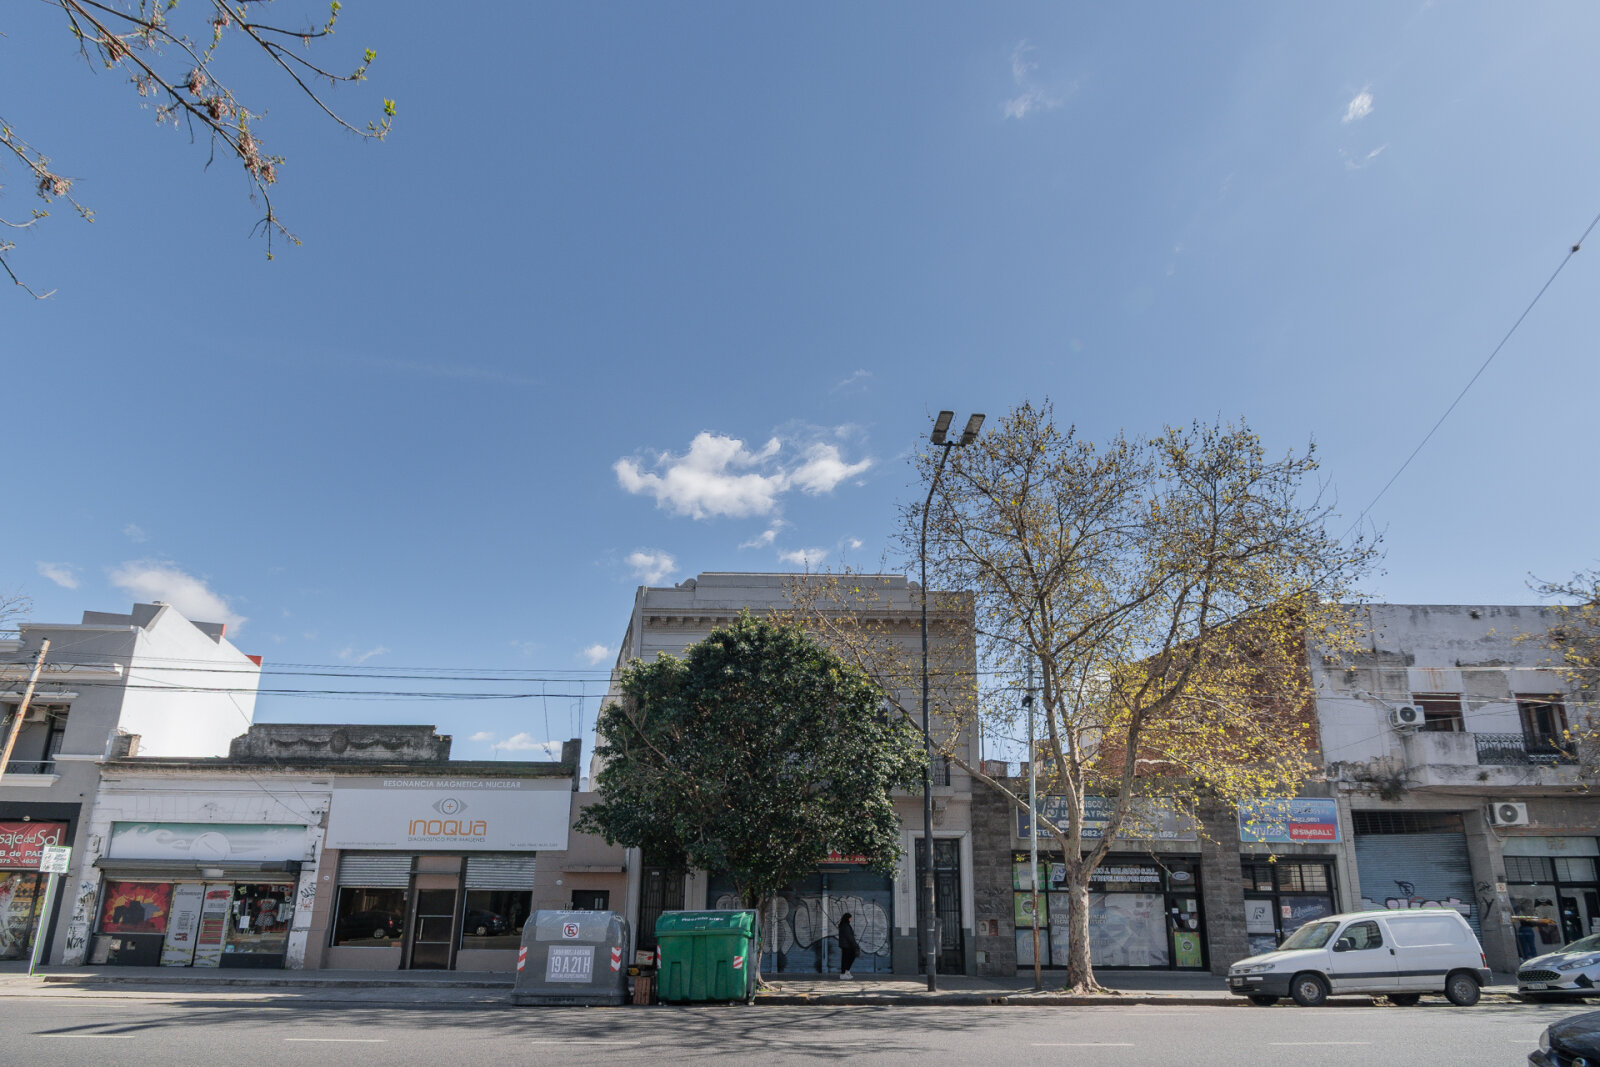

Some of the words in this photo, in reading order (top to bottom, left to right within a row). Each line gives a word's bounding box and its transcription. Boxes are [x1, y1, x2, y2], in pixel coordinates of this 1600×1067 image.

[383, 780, 434, 788] RESONANCIA
[35, 828, 61, 846] Sol
[551, 956, 561, 973] 19
[562, 957, 570, 973] A
[571, 956, 582, 973] 21
[583, 957, 591, 973] H
